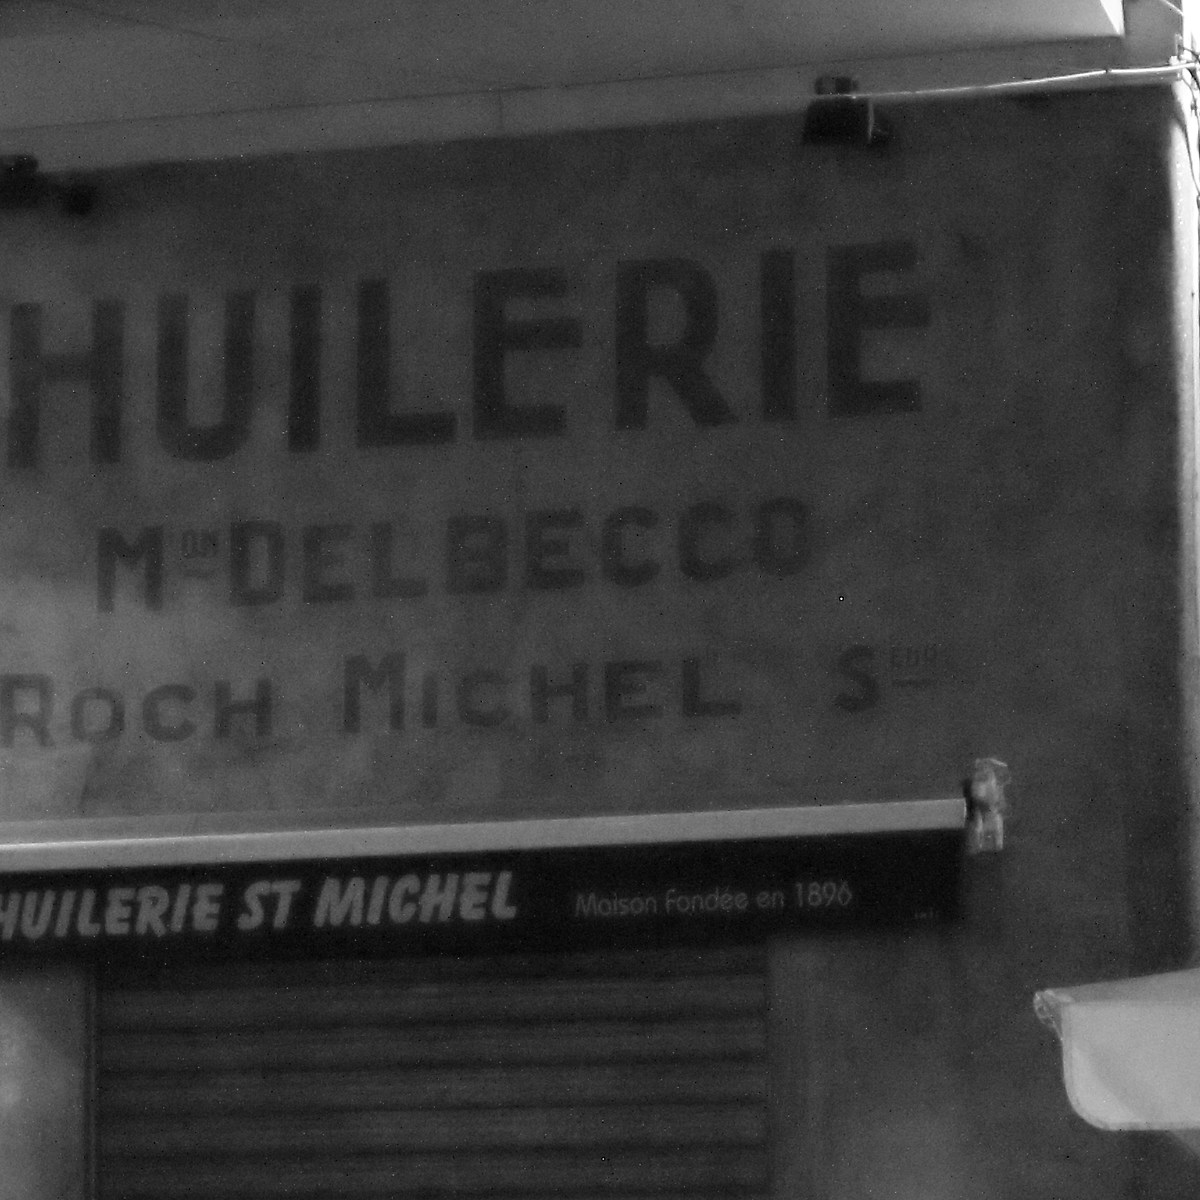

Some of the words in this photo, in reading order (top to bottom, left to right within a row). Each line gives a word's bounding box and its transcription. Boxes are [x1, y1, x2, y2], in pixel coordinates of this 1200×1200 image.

[6, 241, 931, 468] HUILERIE
[229, 497, 813, 608] DELBECCO
[343, 651, 743, 734] MICHEL
[237, 878, 302, 931] ST
[314, 870, 517, 929] MICHEL
[574, 891, 658, 917] Maison
[755, 889, 786, 909] en
[794, 878, 853, 908] 1896
